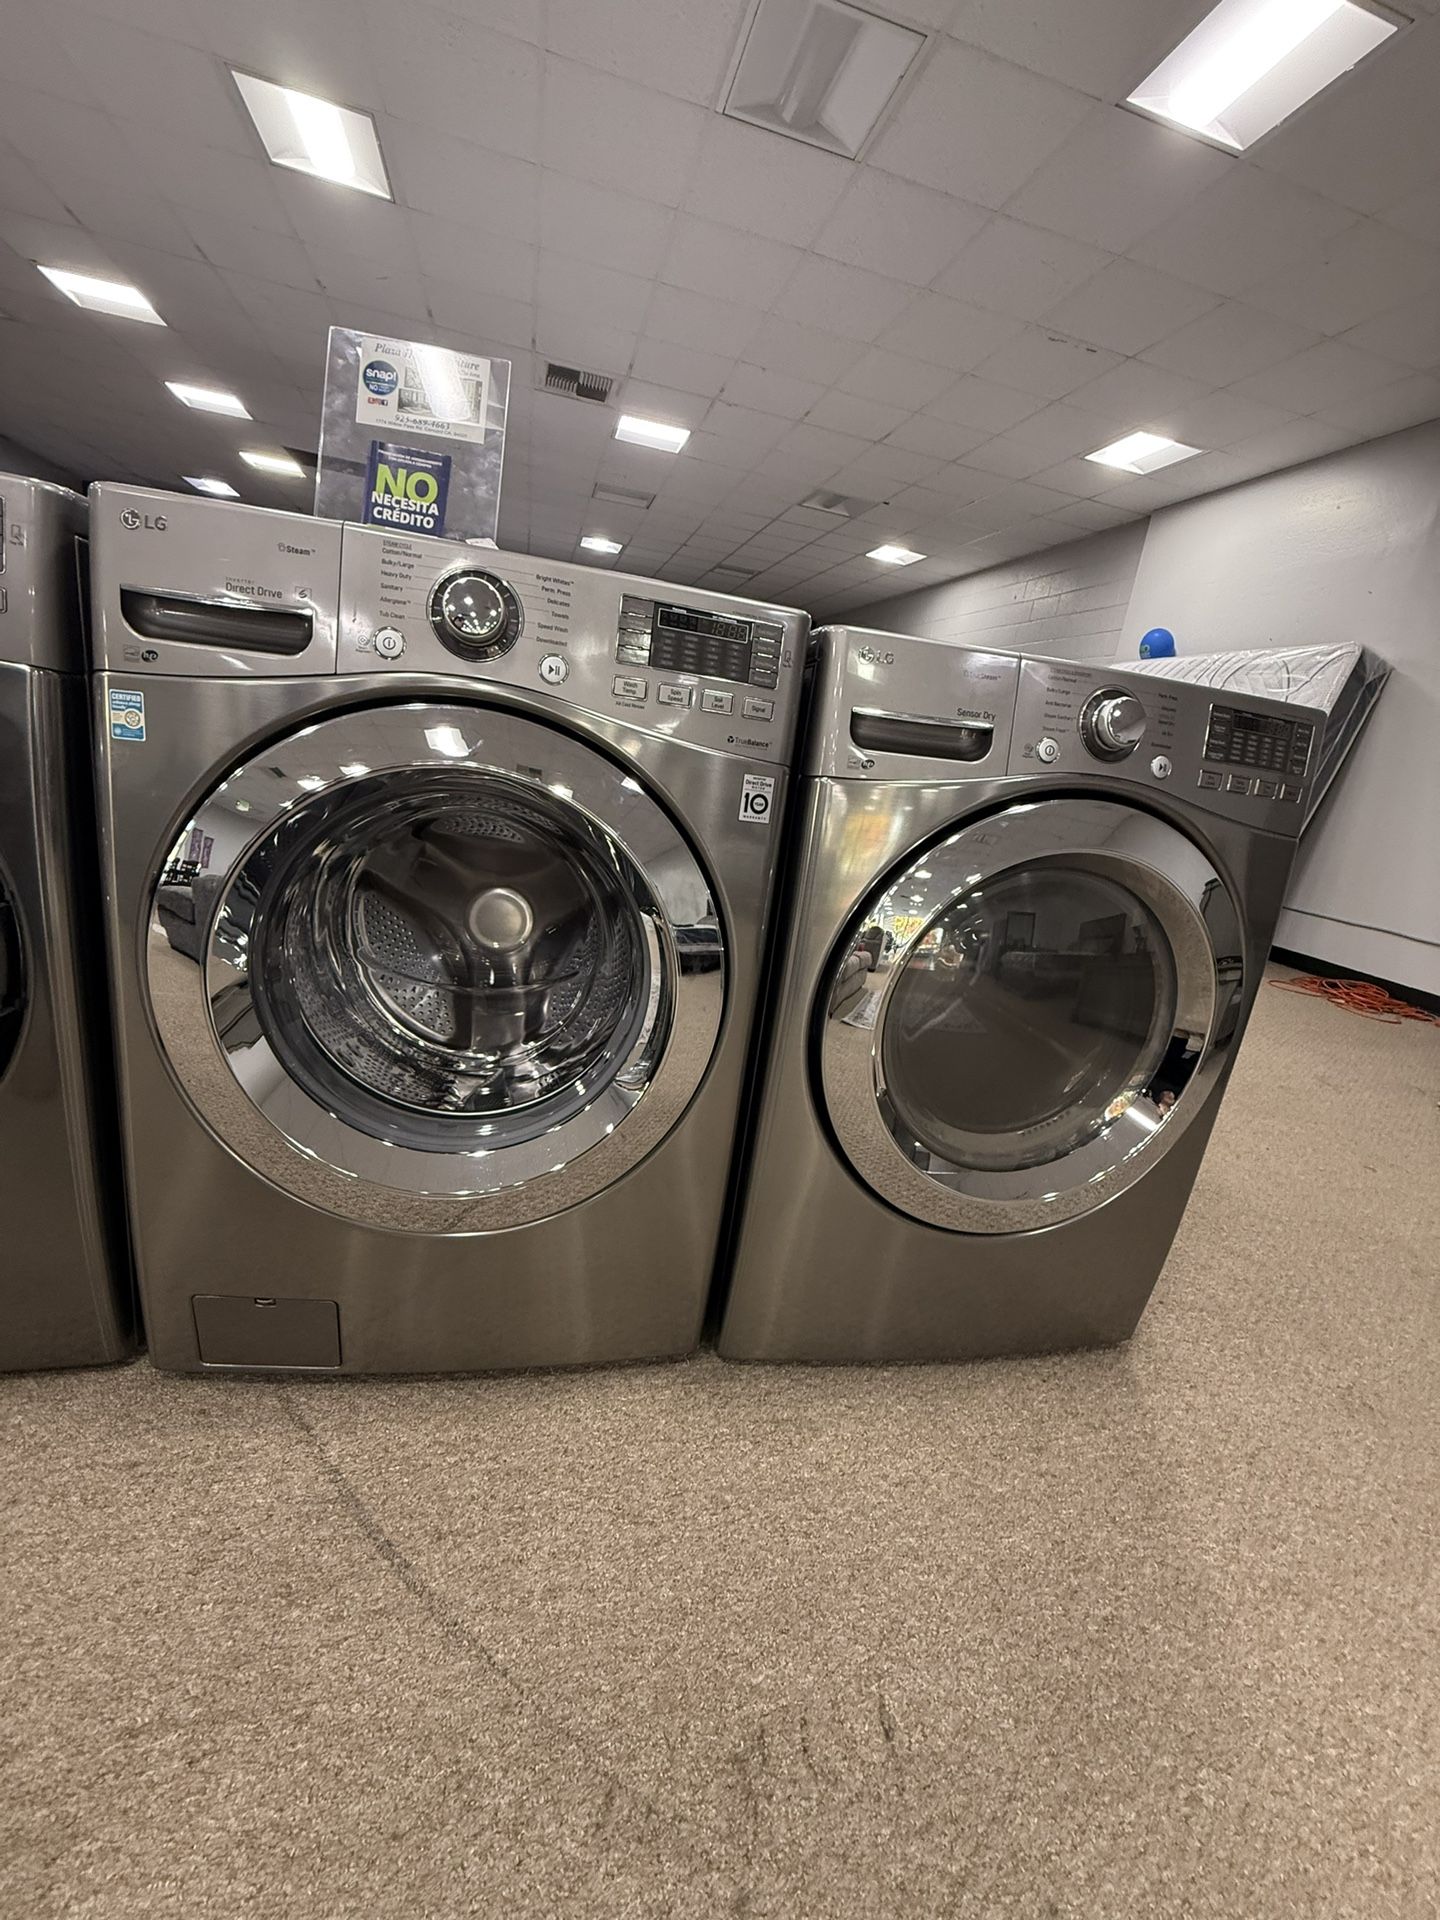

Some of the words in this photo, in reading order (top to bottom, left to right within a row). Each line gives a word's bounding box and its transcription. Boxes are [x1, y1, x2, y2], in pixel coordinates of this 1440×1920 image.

[366, 368, 396, 381] snap!
[375, 463, 439, 504] NO
[371, 490, 440, 516] NECESITA
[144, 514, 167, 531] LG
[373, 506, 435, 529] CRÉDITO
[381, 558, 415, 570] Bulky/Large
[225, 582, 255, 596] Direct
[257, 586, 283, 599] Drive
[380, 582, 403, 592] Sanitary
[957, 707, 981, 719] Sensor
[983, 710, 997, 721] Dry
[744, 792, 769, 815] 10
